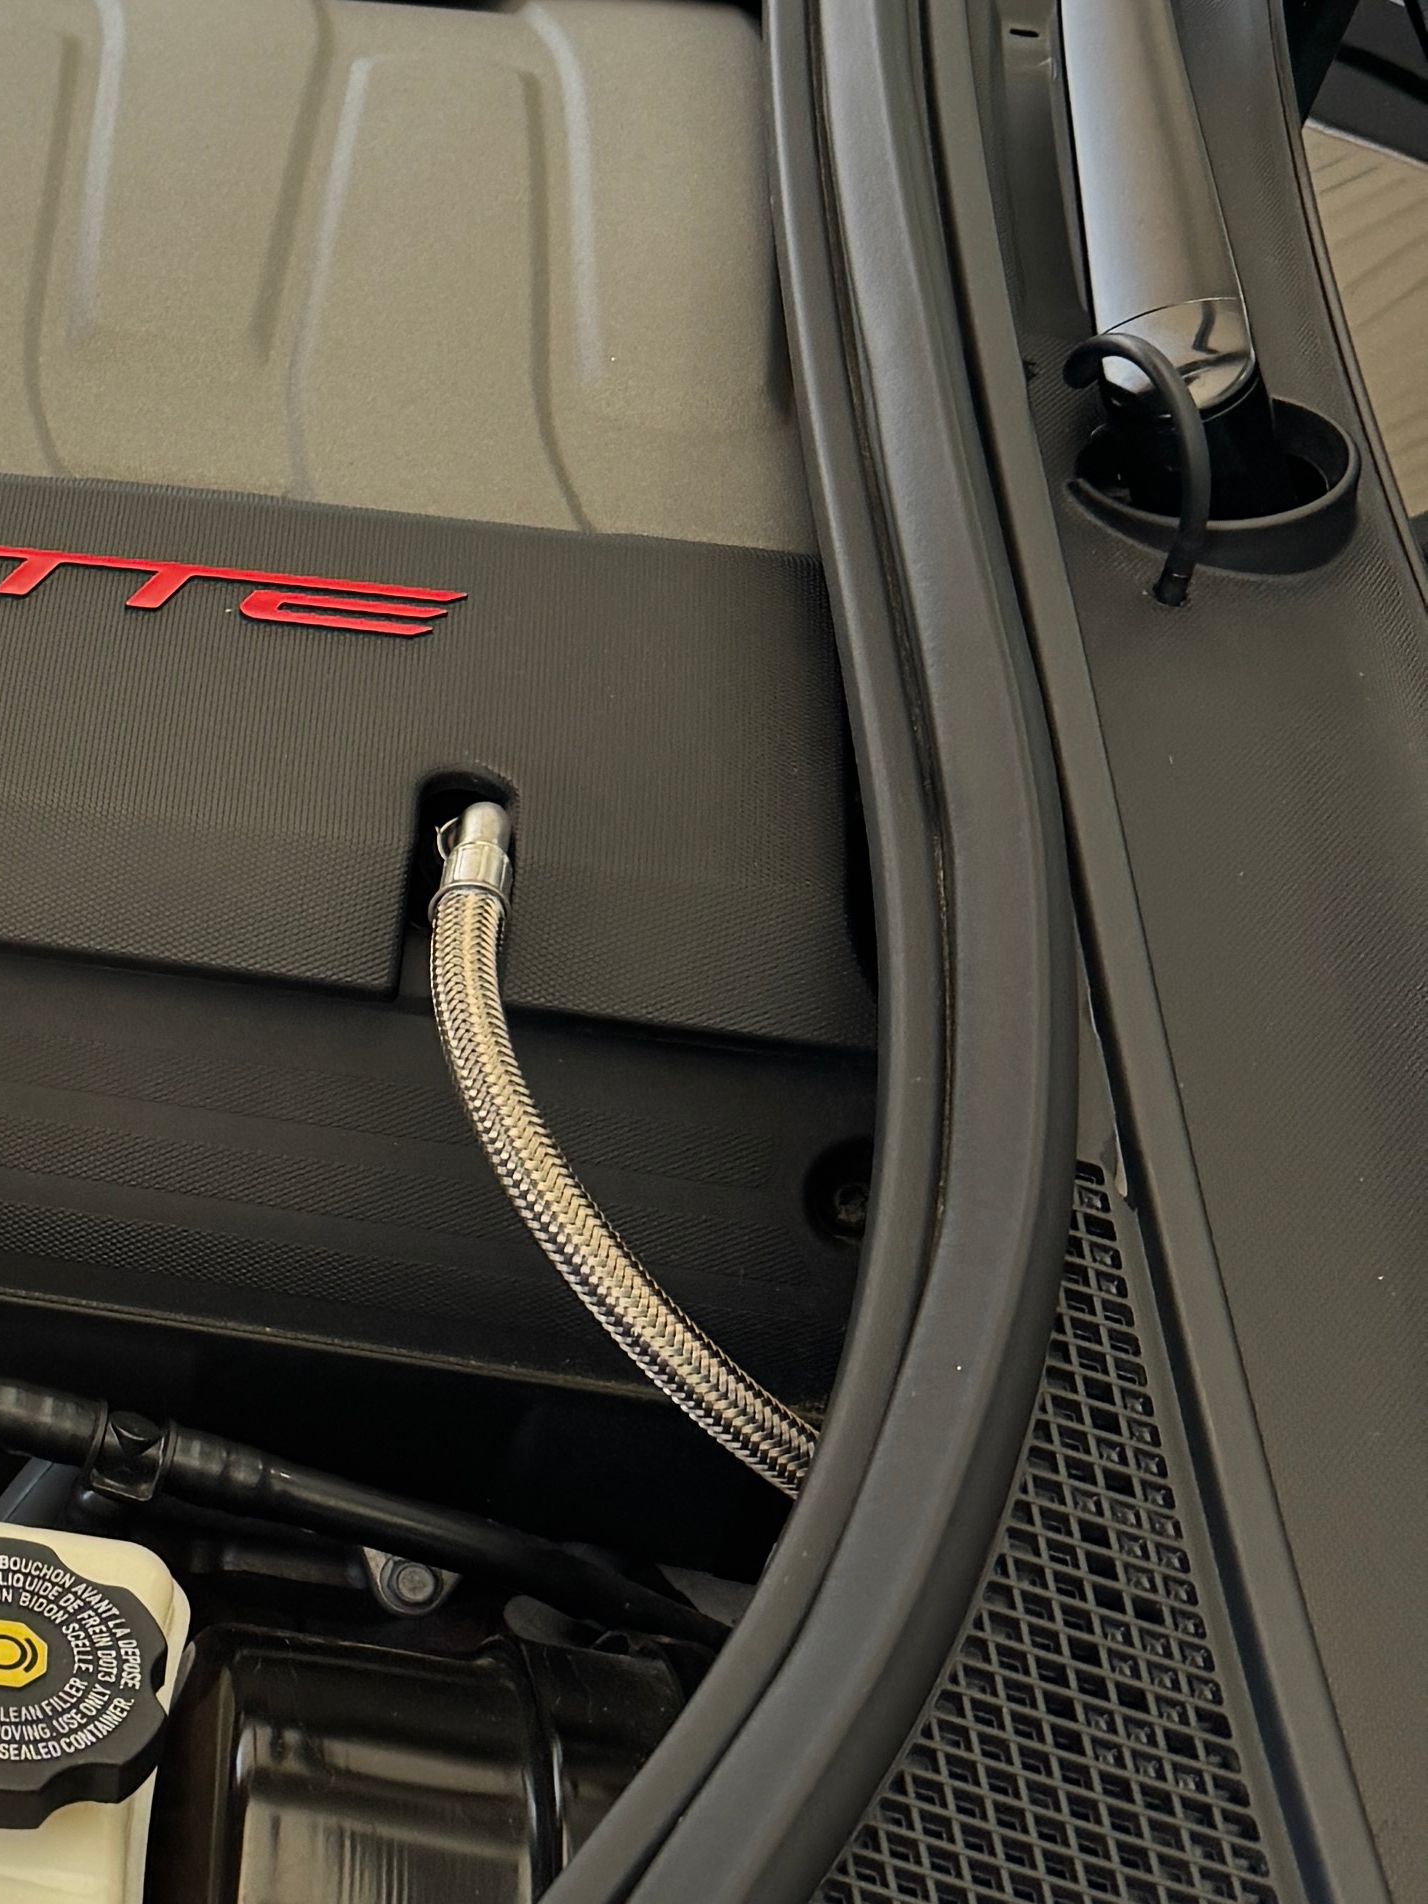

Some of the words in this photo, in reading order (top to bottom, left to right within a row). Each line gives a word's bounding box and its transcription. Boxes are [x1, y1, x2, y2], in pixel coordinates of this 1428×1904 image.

[19, 1591, 69, 1624] BIDON
[62, 1622, 94, 1674] SCELLE
[58, 1593, 84, 1613] DE
[76, 1610, 113, 1647] FREIN
[97, 1650, 118, 1683] DOT3
[71, 1583, 120, 1618] AVANT
[107, 1618, 131, 1638] LA
[41, 1677, 89, 1716] FILLER
[52, 1708, 87, 1734] USE
[79, 1683, 111, 1716] ONLY
[60, 1697, 135, 1754] CONTAINER.
